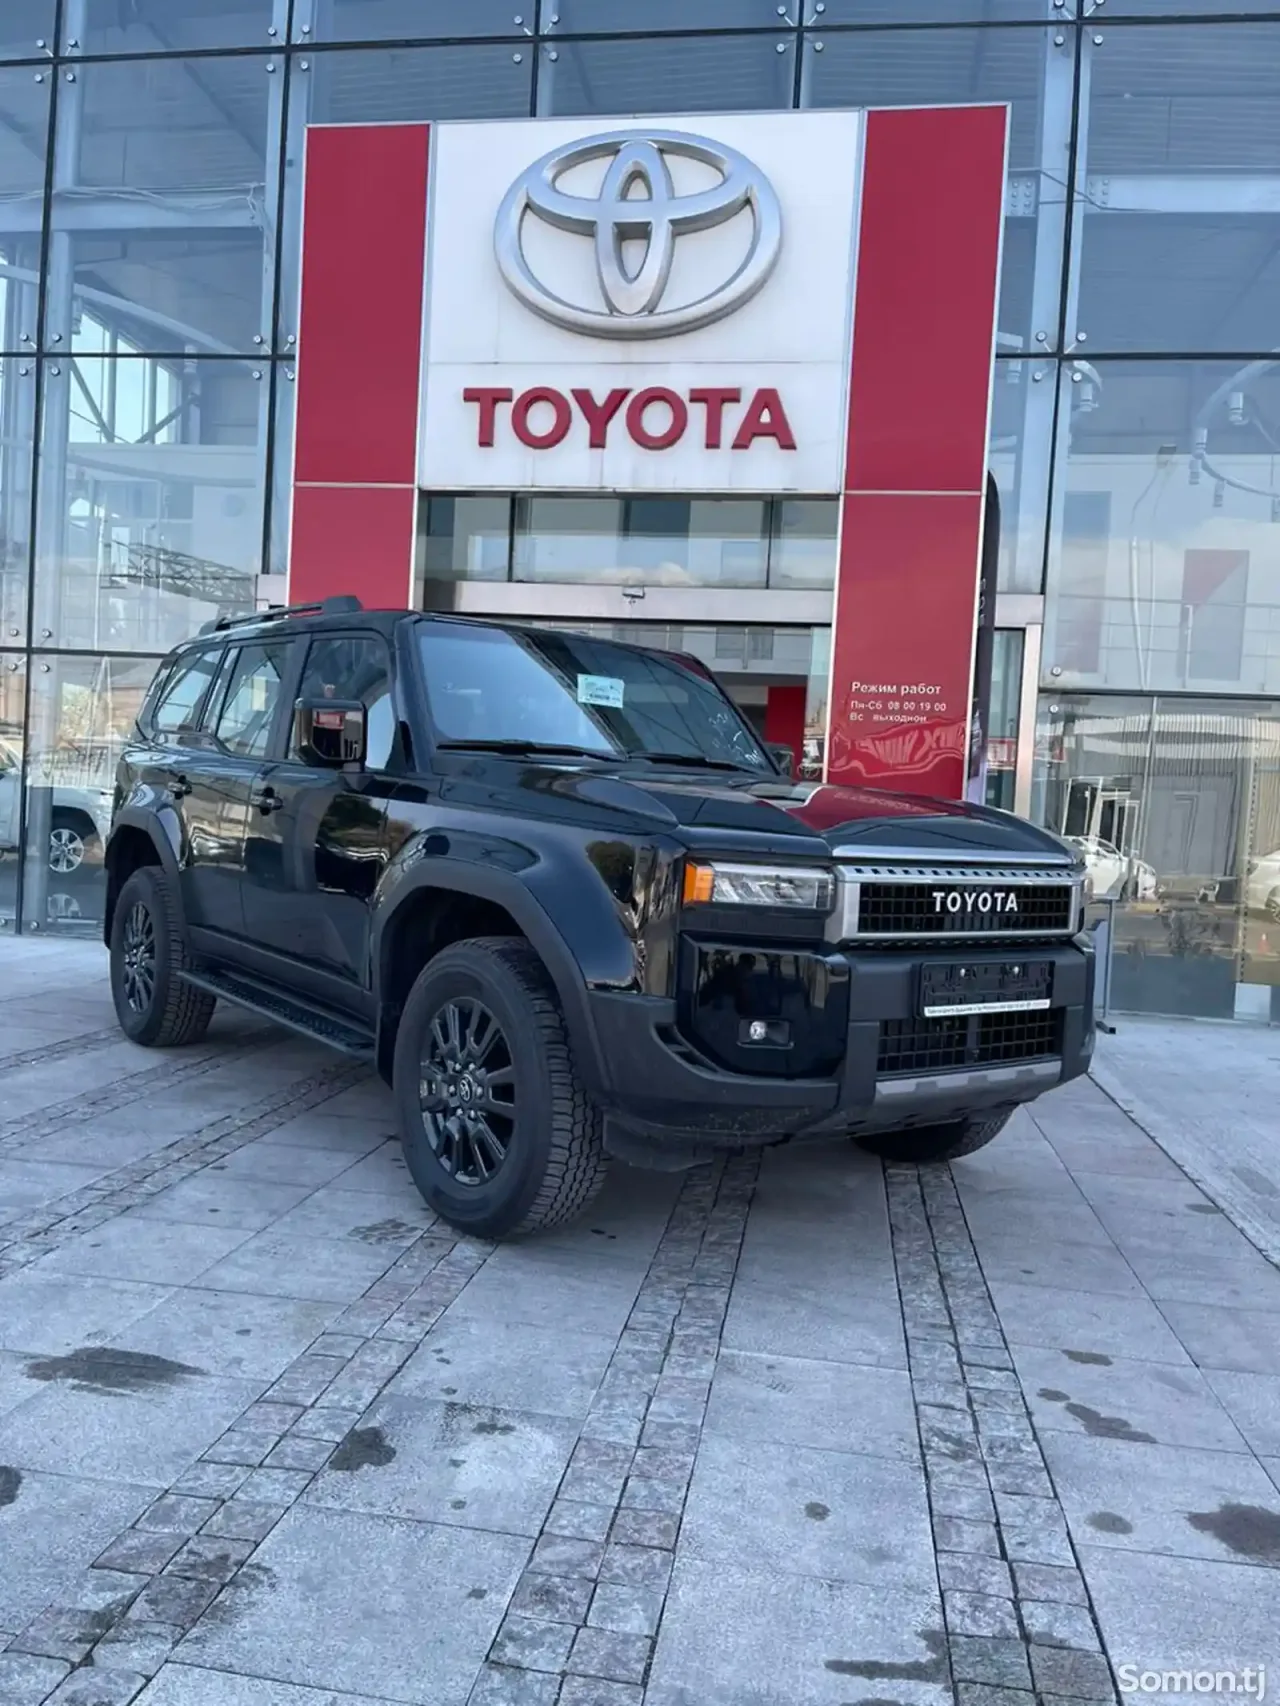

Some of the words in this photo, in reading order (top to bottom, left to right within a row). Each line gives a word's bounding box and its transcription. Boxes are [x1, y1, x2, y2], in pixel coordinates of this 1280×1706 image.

[463, 386, 797, 451] TOYOTA
[851, 681, 897, 694] Режим
[900, 683, 942, 697] работ
[932, 892, 1018, 912] TOYOTA
